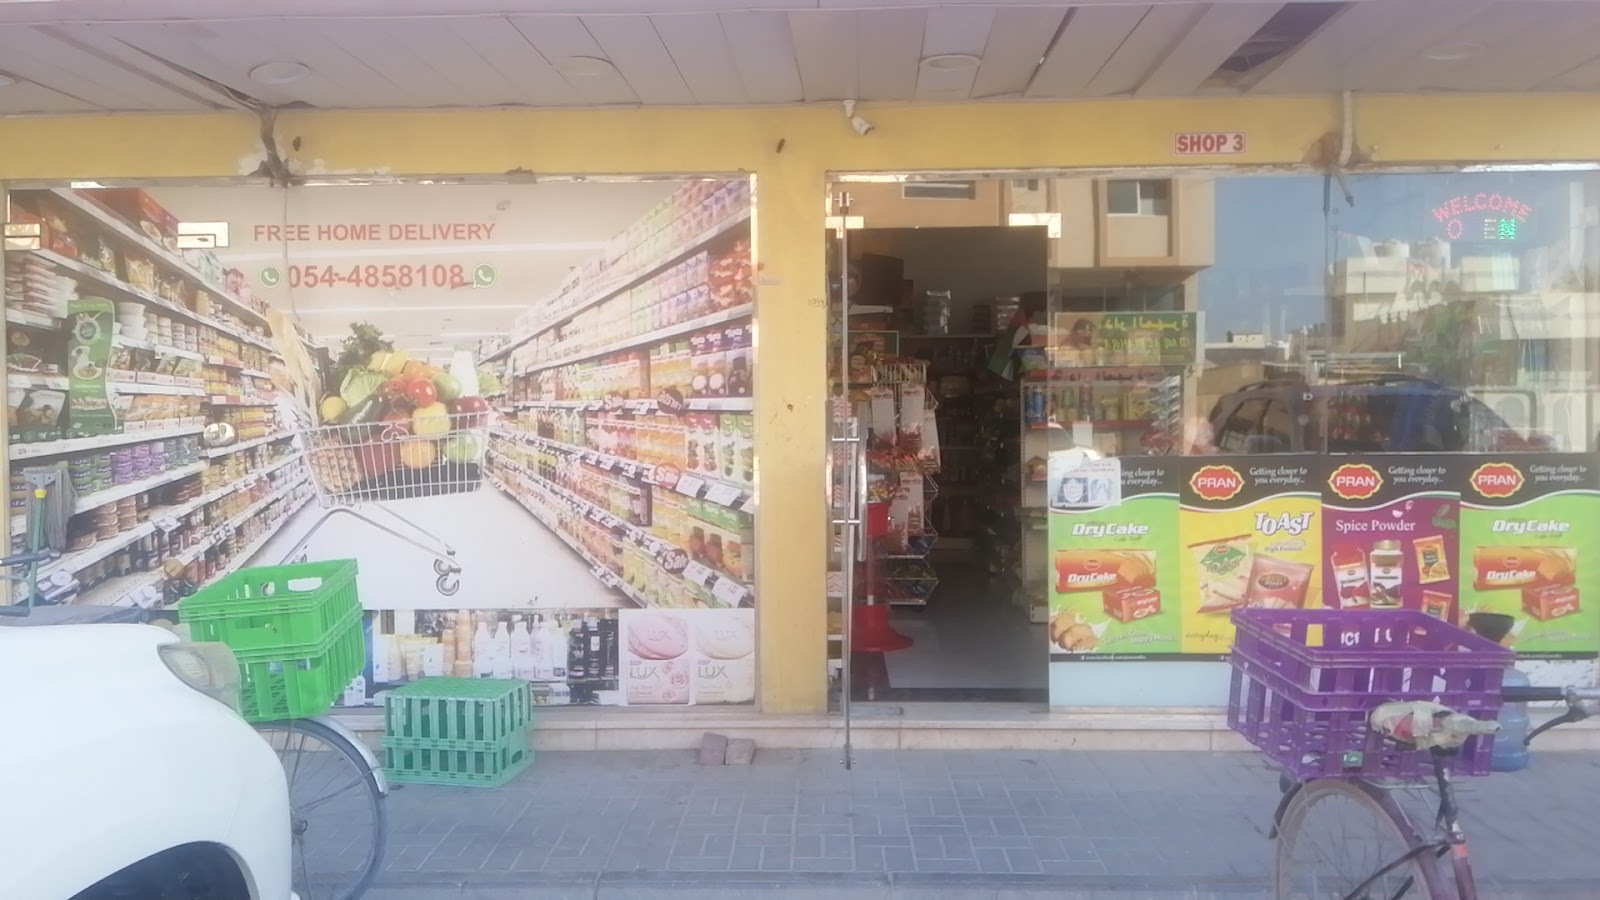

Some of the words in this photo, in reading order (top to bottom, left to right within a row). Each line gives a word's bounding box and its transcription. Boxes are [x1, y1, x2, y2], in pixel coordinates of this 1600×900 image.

[1177, 134, 1228, 152] SHOP
[1232, 134, 1243, 152] 3
[1432, 192, 1532, 222] WELCOME
[254, 224, 310, 241] FREE
[317, 224, 381, 241] HOME
[389, 223, 496, 241] DELIVERY
[1447, 218, 1517, 240] OEN
[288, 264, 465, 289] 054-4858108
[1134, 467, 1155, 477] closer
[1156, 468, 1165, 477] to
[1249, 467, 1276, 477] Getting
[1277, 466, 1297, 476] closer
[1299, 467, 1307, 475] to
[1388, 466, 1415, 476] Getting
[1416, 464, 1437, 474] closer
[1438, 466, 1446, 474] to
[1579, 465, 1587, 473] to
[1197, 477, 1236, 488] PRAN
[1254, 477, 1268, 486] you
[1336, 476, 1375, 487] PRAN
[1393, 476, 1407, 485] you
[1478, 475, 1516, 486] PRAN
[1254, 512, 1314, 536] TOAST
[1335, 519, 1368, 534] Spice
[1371, 519, 1416, 532] Powder
[629, 666, 660, 680] LUX
[697, 666, 728, 680] LUX
